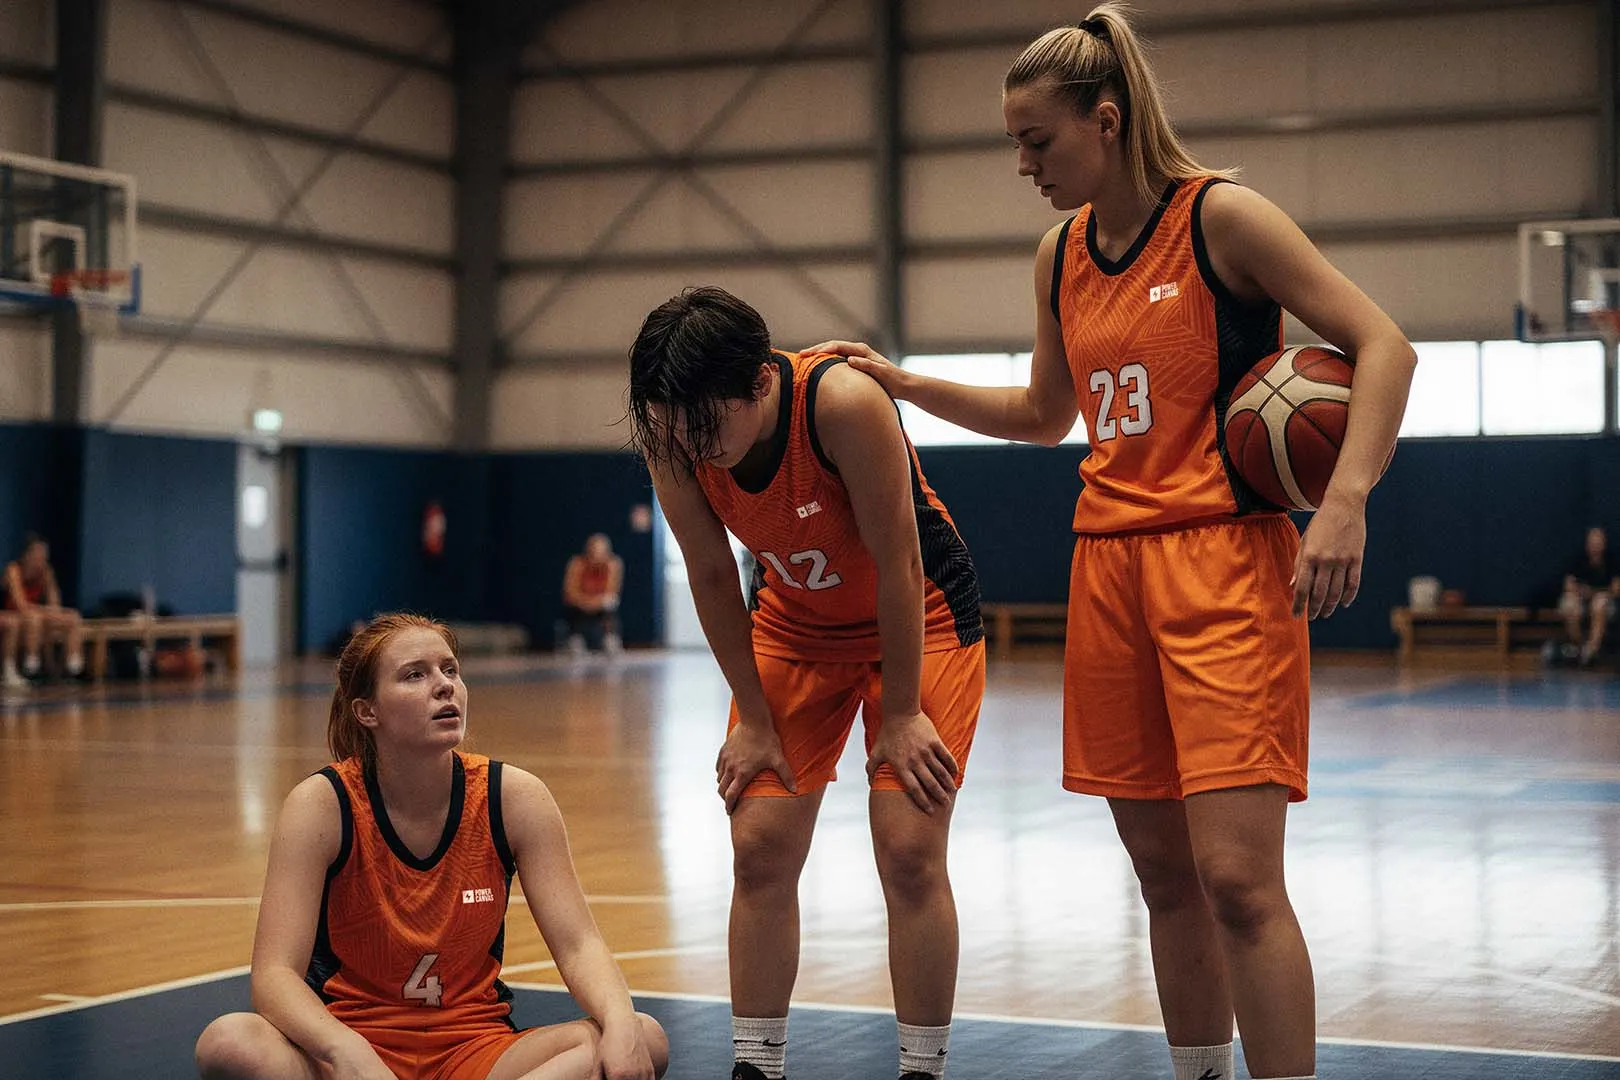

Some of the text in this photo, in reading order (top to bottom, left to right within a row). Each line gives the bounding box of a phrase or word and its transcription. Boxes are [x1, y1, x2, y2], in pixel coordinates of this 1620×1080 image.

[1089, 363, 1153, 442] 23
[759, 549, 843, 591] 12
[474, 888, 492, 896] POWER
[475, 894, 495, 903] CANVAS
[402, 953, 443, 1007] 4
